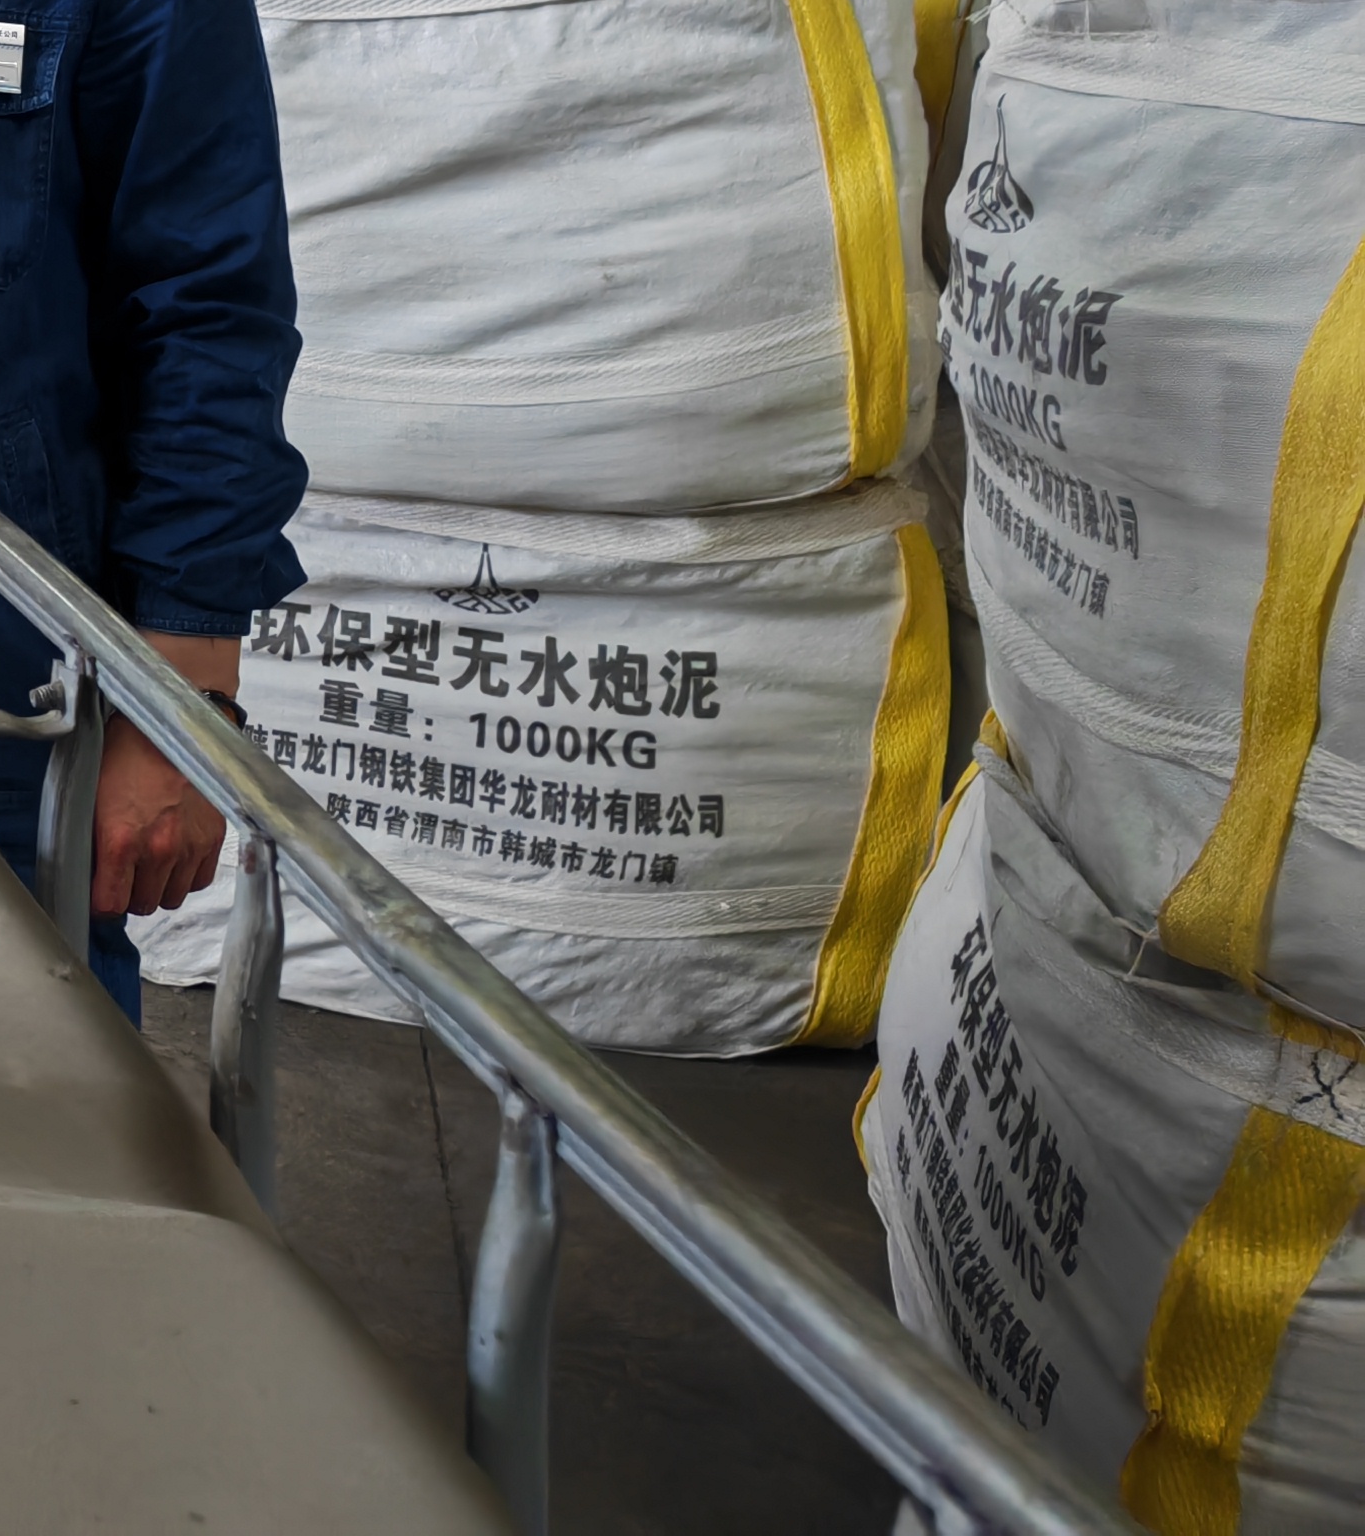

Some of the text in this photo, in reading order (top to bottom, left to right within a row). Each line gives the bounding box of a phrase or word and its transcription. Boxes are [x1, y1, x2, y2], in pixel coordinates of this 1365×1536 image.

[250, 600, 721, 720] 环保型无水炮泥
[325, 792, 680, 885] 陕西省渭南市韩城市龙门镇
